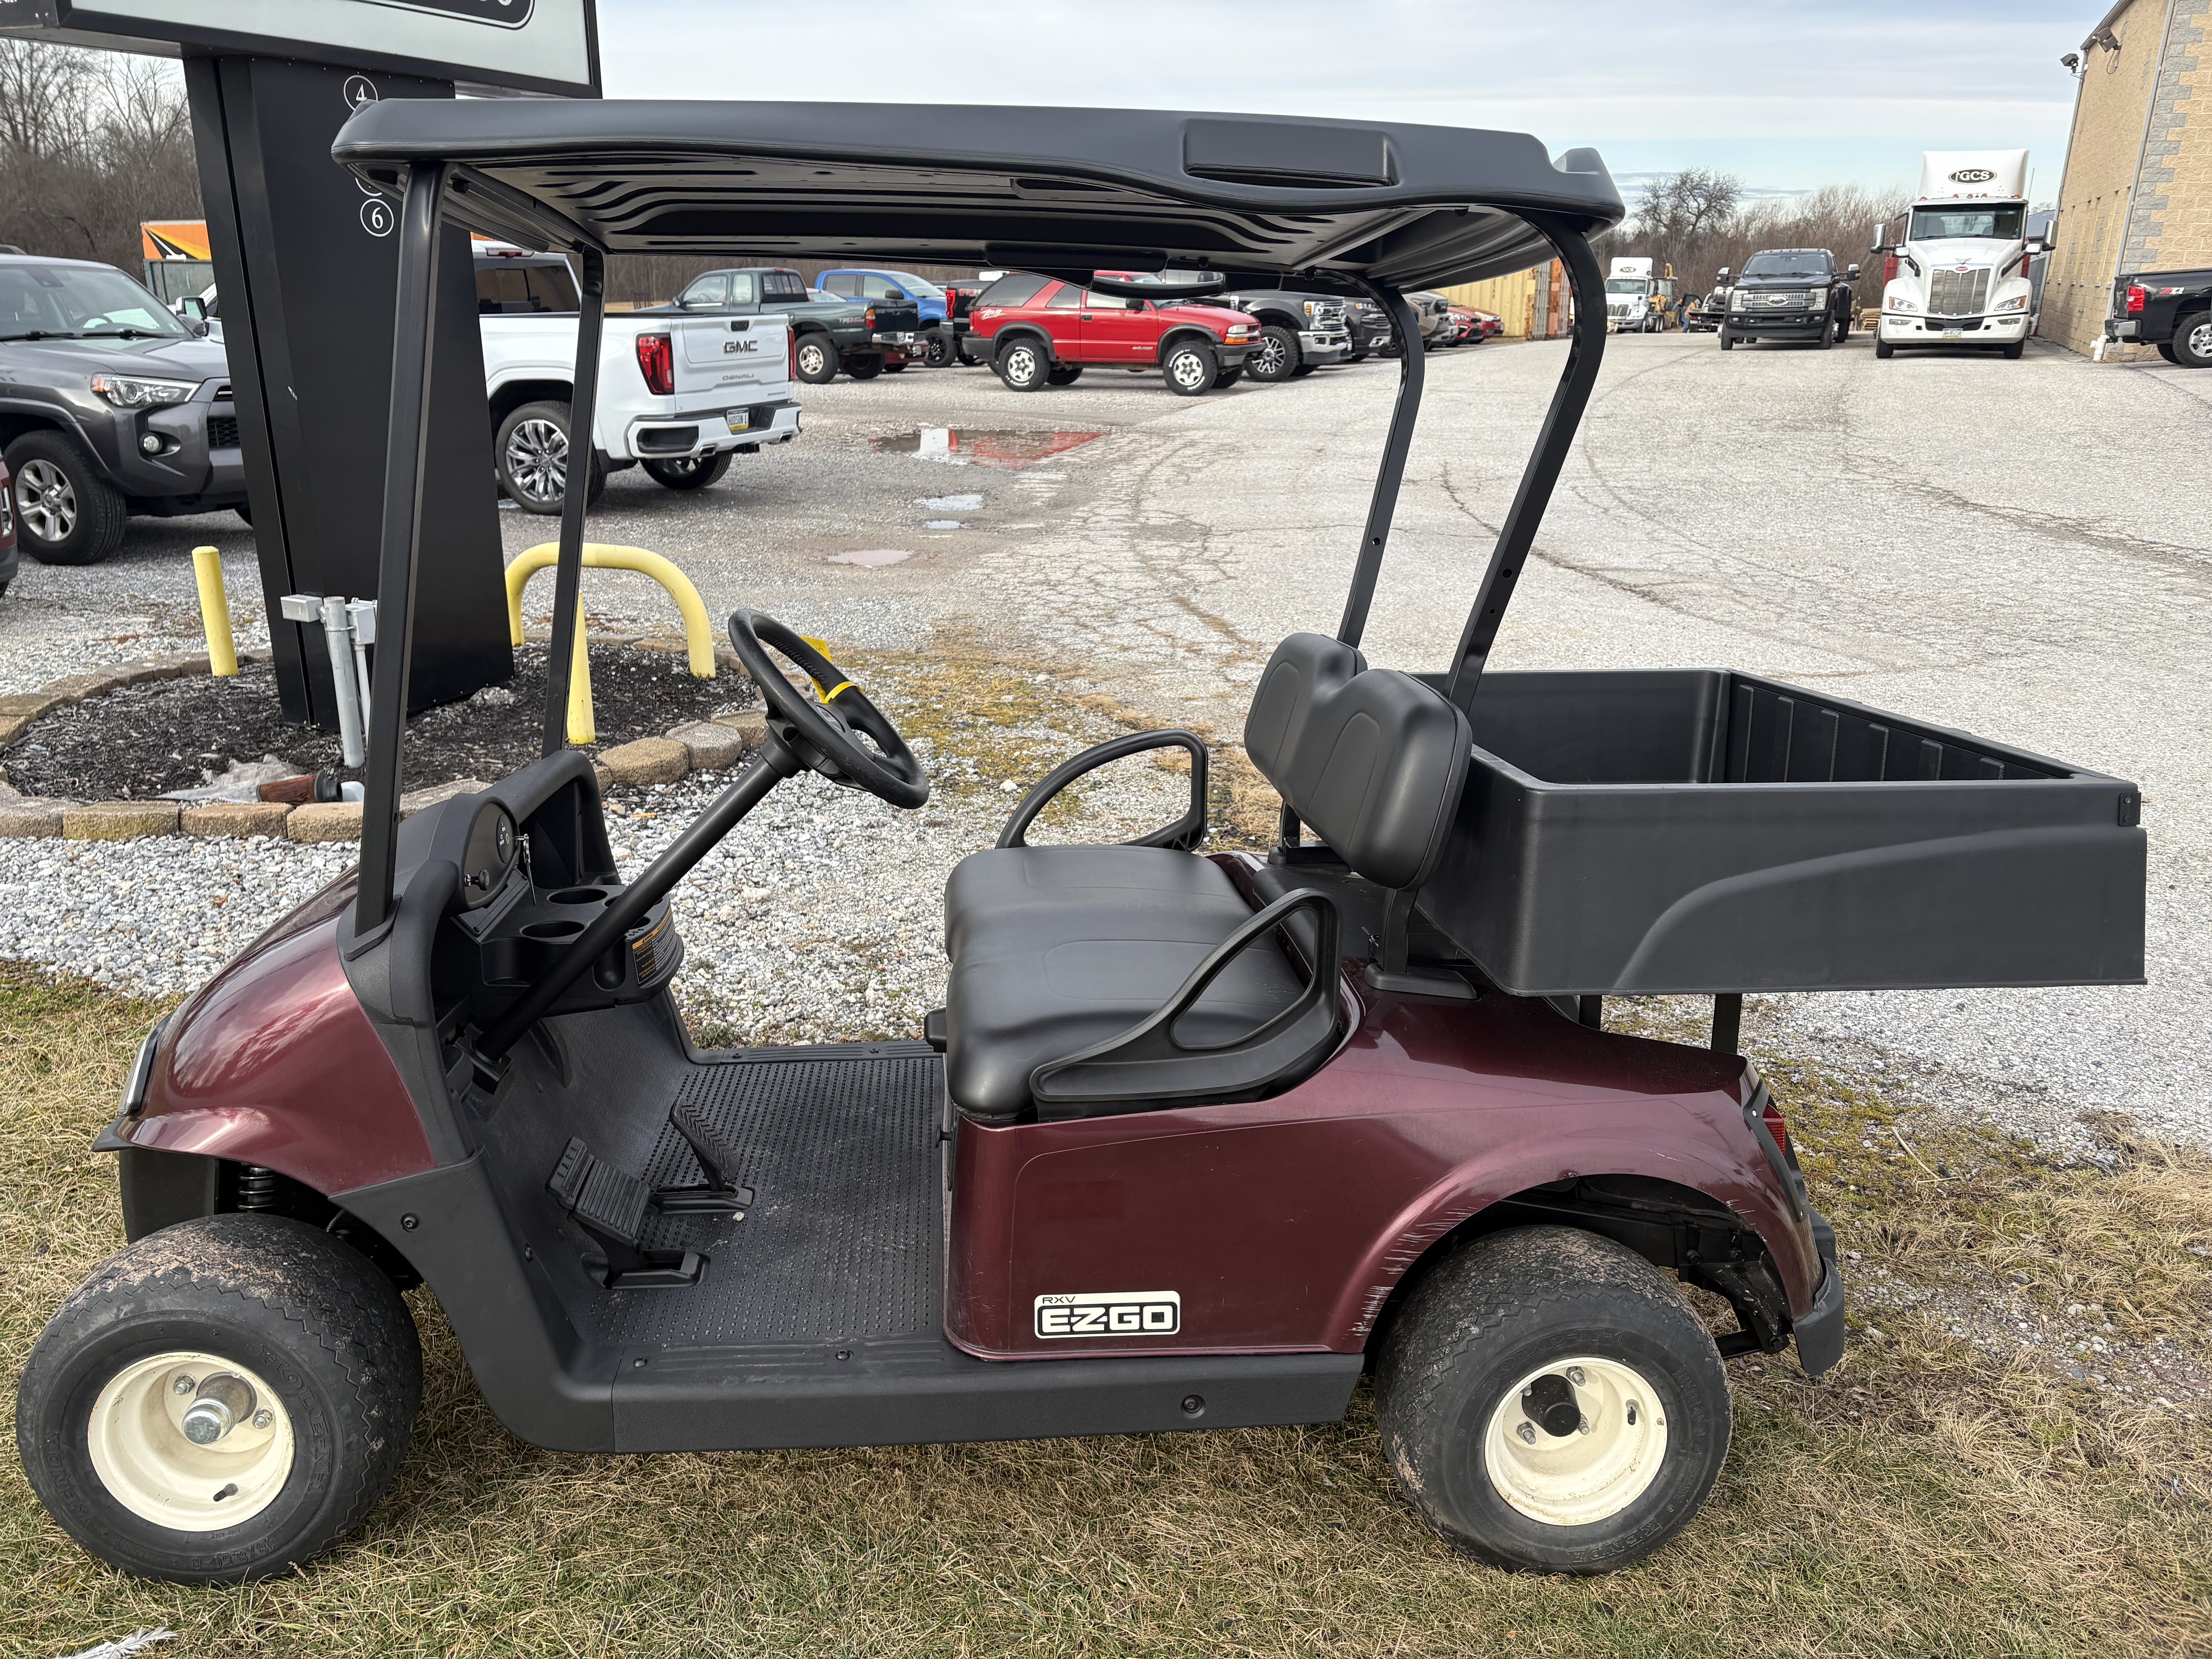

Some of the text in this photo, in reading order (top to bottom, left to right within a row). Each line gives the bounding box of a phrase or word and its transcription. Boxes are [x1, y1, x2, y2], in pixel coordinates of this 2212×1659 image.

[356, 84, 367, 101] 4
[372, 207, 383, 229] 6
[723, 340, 758, 354] GMC
[1042, 1296, 1076, 1304] RXV
[1567, 1517, 1661, 1563] KENDA
